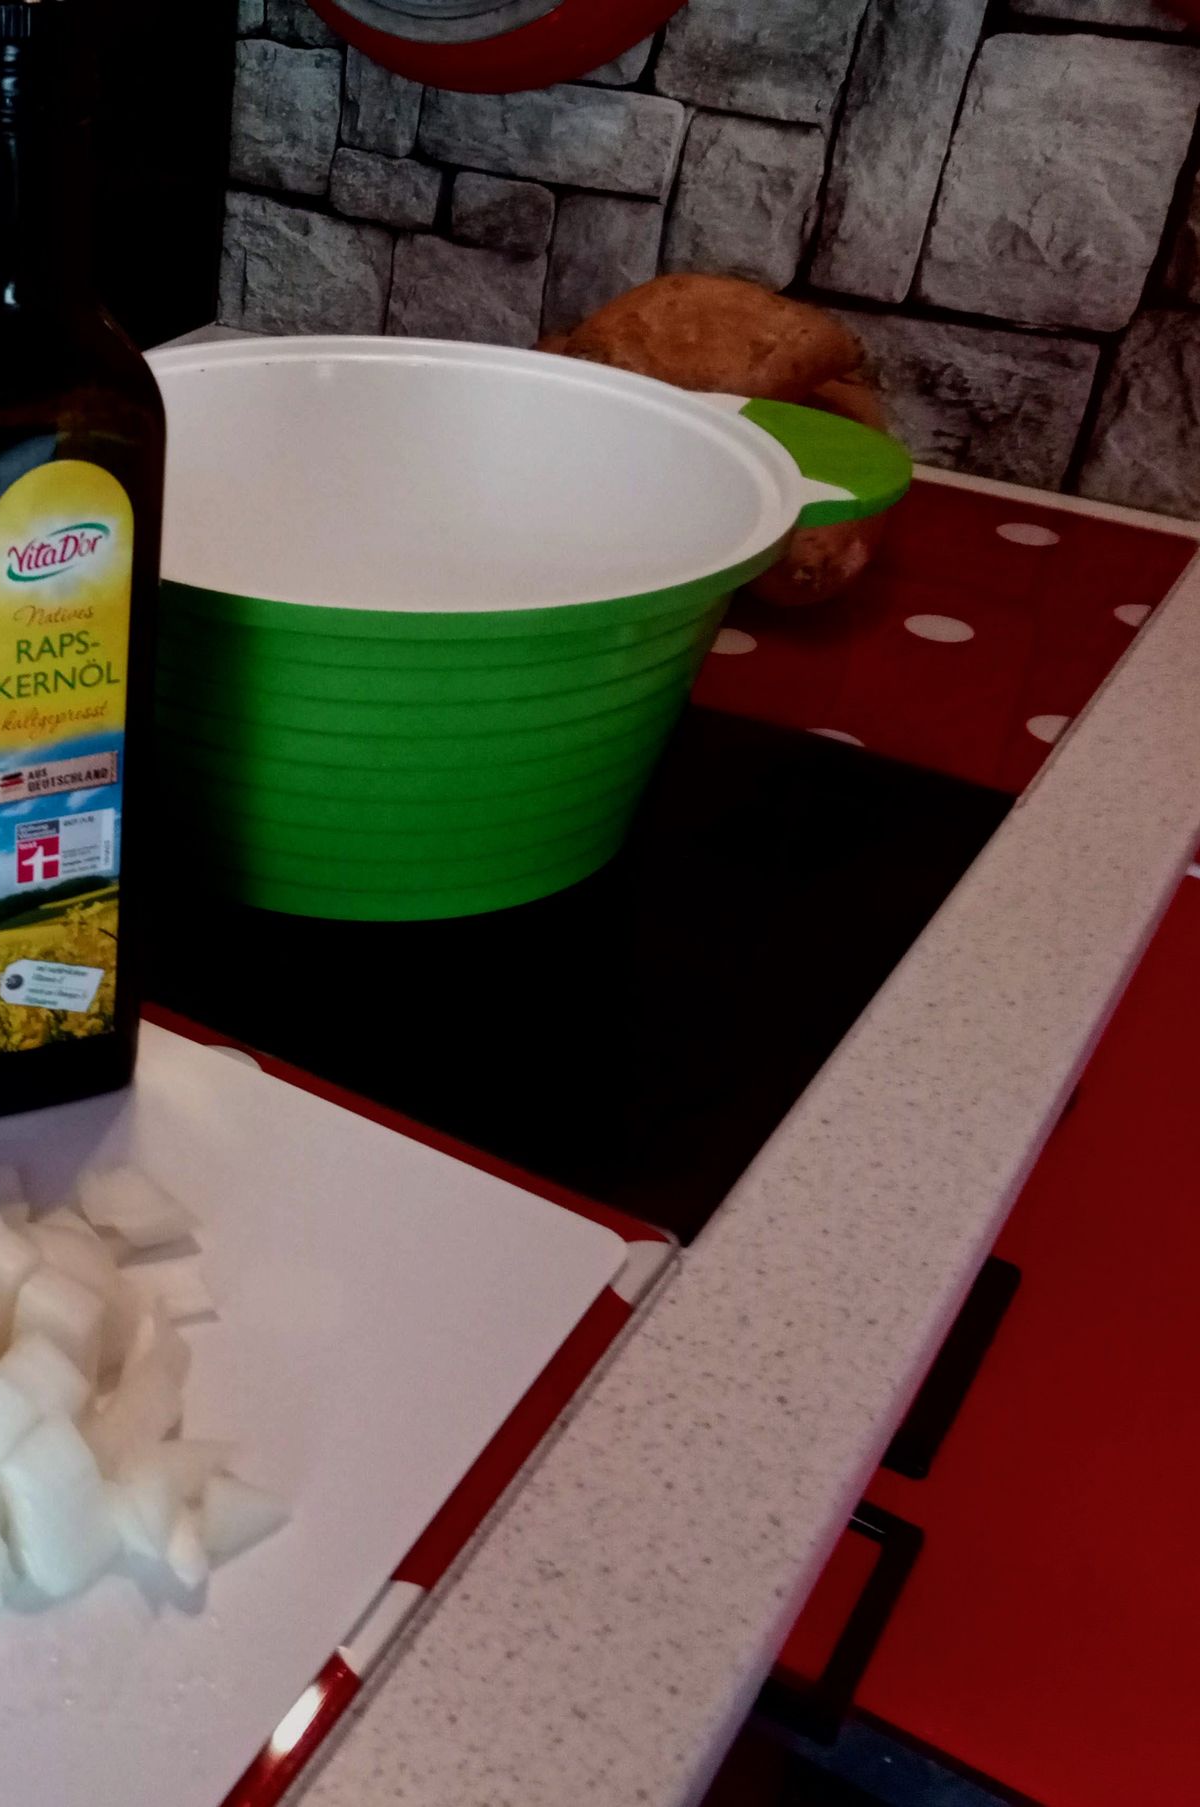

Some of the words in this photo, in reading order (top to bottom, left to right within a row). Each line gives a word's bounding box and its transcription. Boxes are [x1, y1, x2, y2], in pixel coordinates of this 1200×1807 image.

[16, 631, 100, 664] RAPS-
[27, 767, 48, 781] AUS
[27, 767, 109, 793] DEUTSCHLAND
